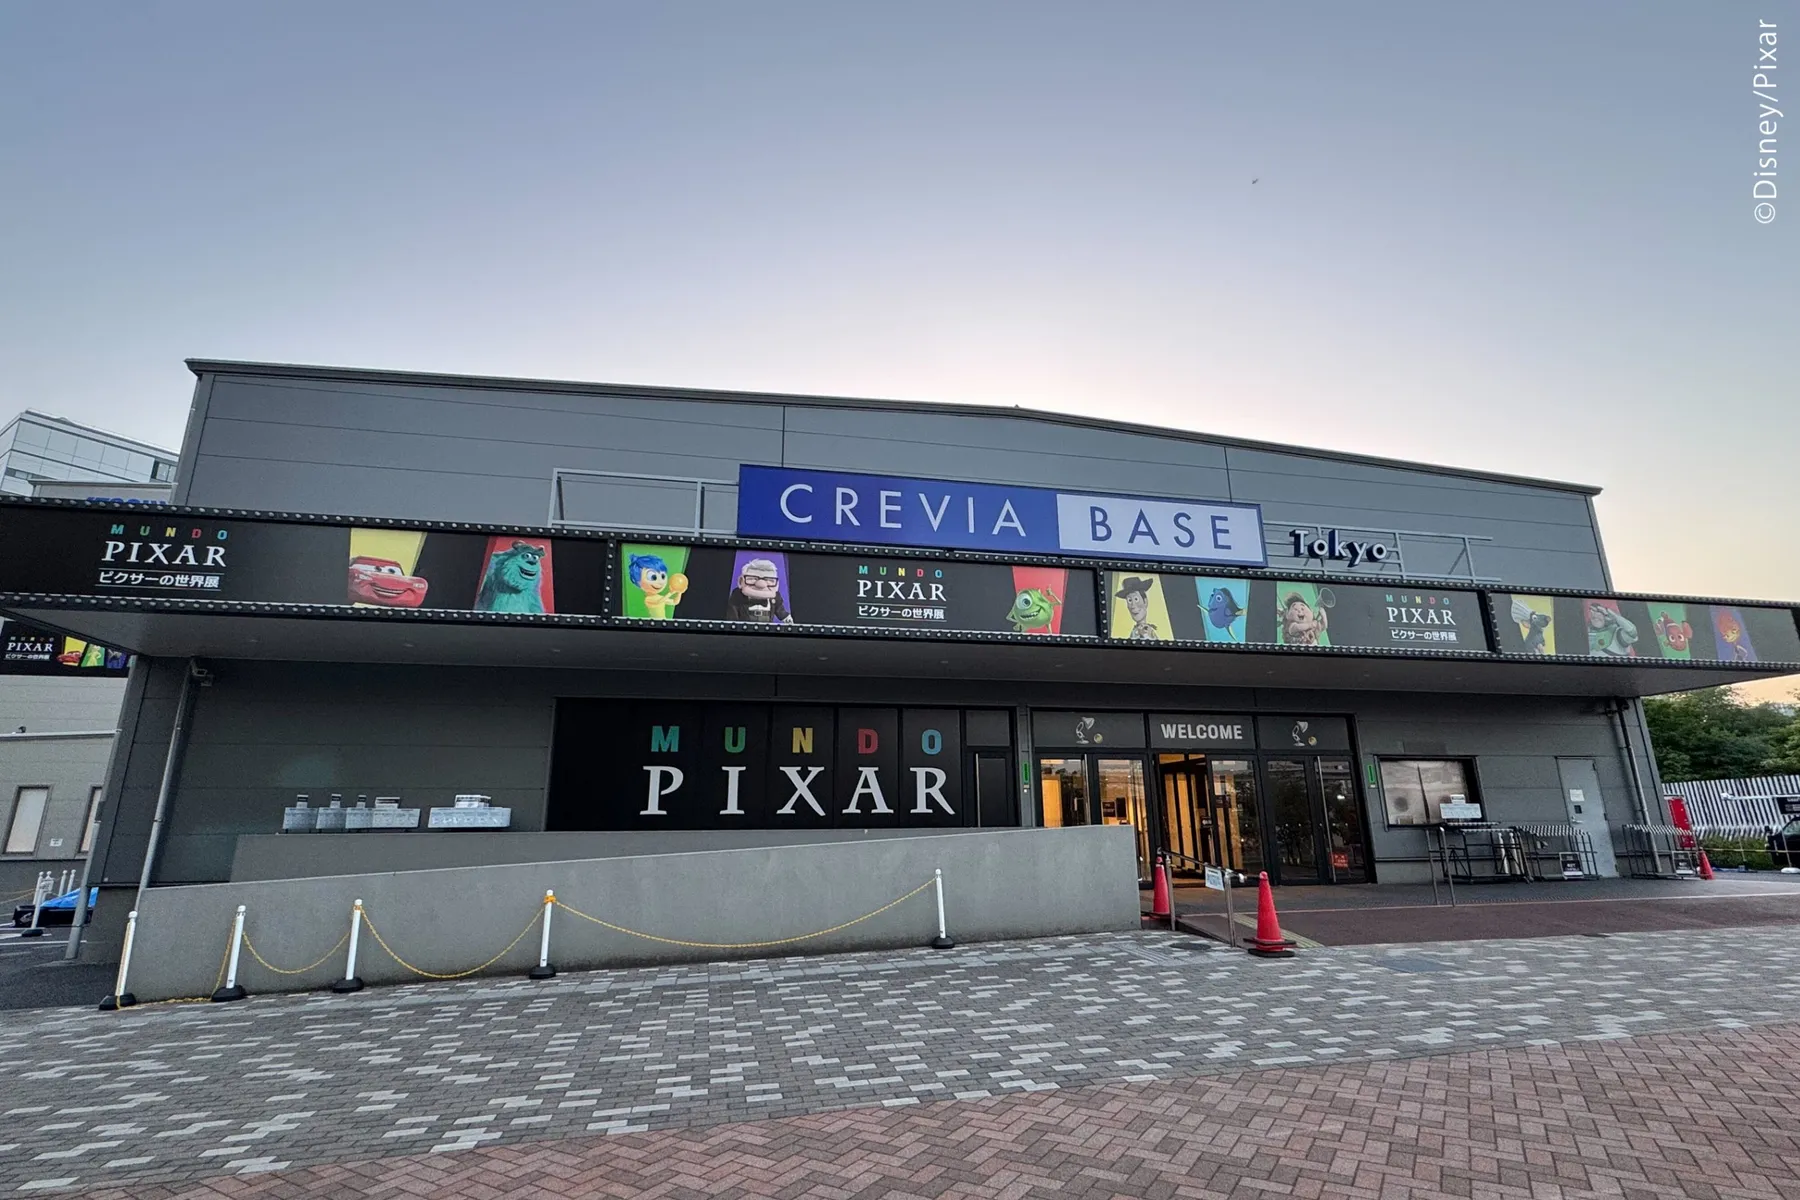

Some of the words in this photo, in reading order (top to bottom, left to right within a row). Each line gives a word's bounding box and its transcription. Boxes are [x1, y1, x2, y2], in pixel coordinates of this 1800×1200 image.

[110, 524, 228, 540] MUNDO
[779, 483, 1027, 537] CREVIA
[1090, 505, 1233, 550] BASE
[1289, 528, 1388, 568] Tokyo
[101, 540, 227, 567] PIXAR
[99, 570, 220, 588] ピクサーの世界展
[858, 565, 943, 578] MUNDO
[856, 579, 947, 602] PIXAR
[1385, 594, 1450, 605] MUNDO
[858, 605, 945, 620] ピクサーの世界展
[1386, 606, 1457, 626] PIXAR
[6, 642, 53, 652] PIXAR
[650, 725, 943, 755] MUNDO
[1160, 723, 1243, 741] WELCOME
[639, 765, 956, 817] PIXAR
